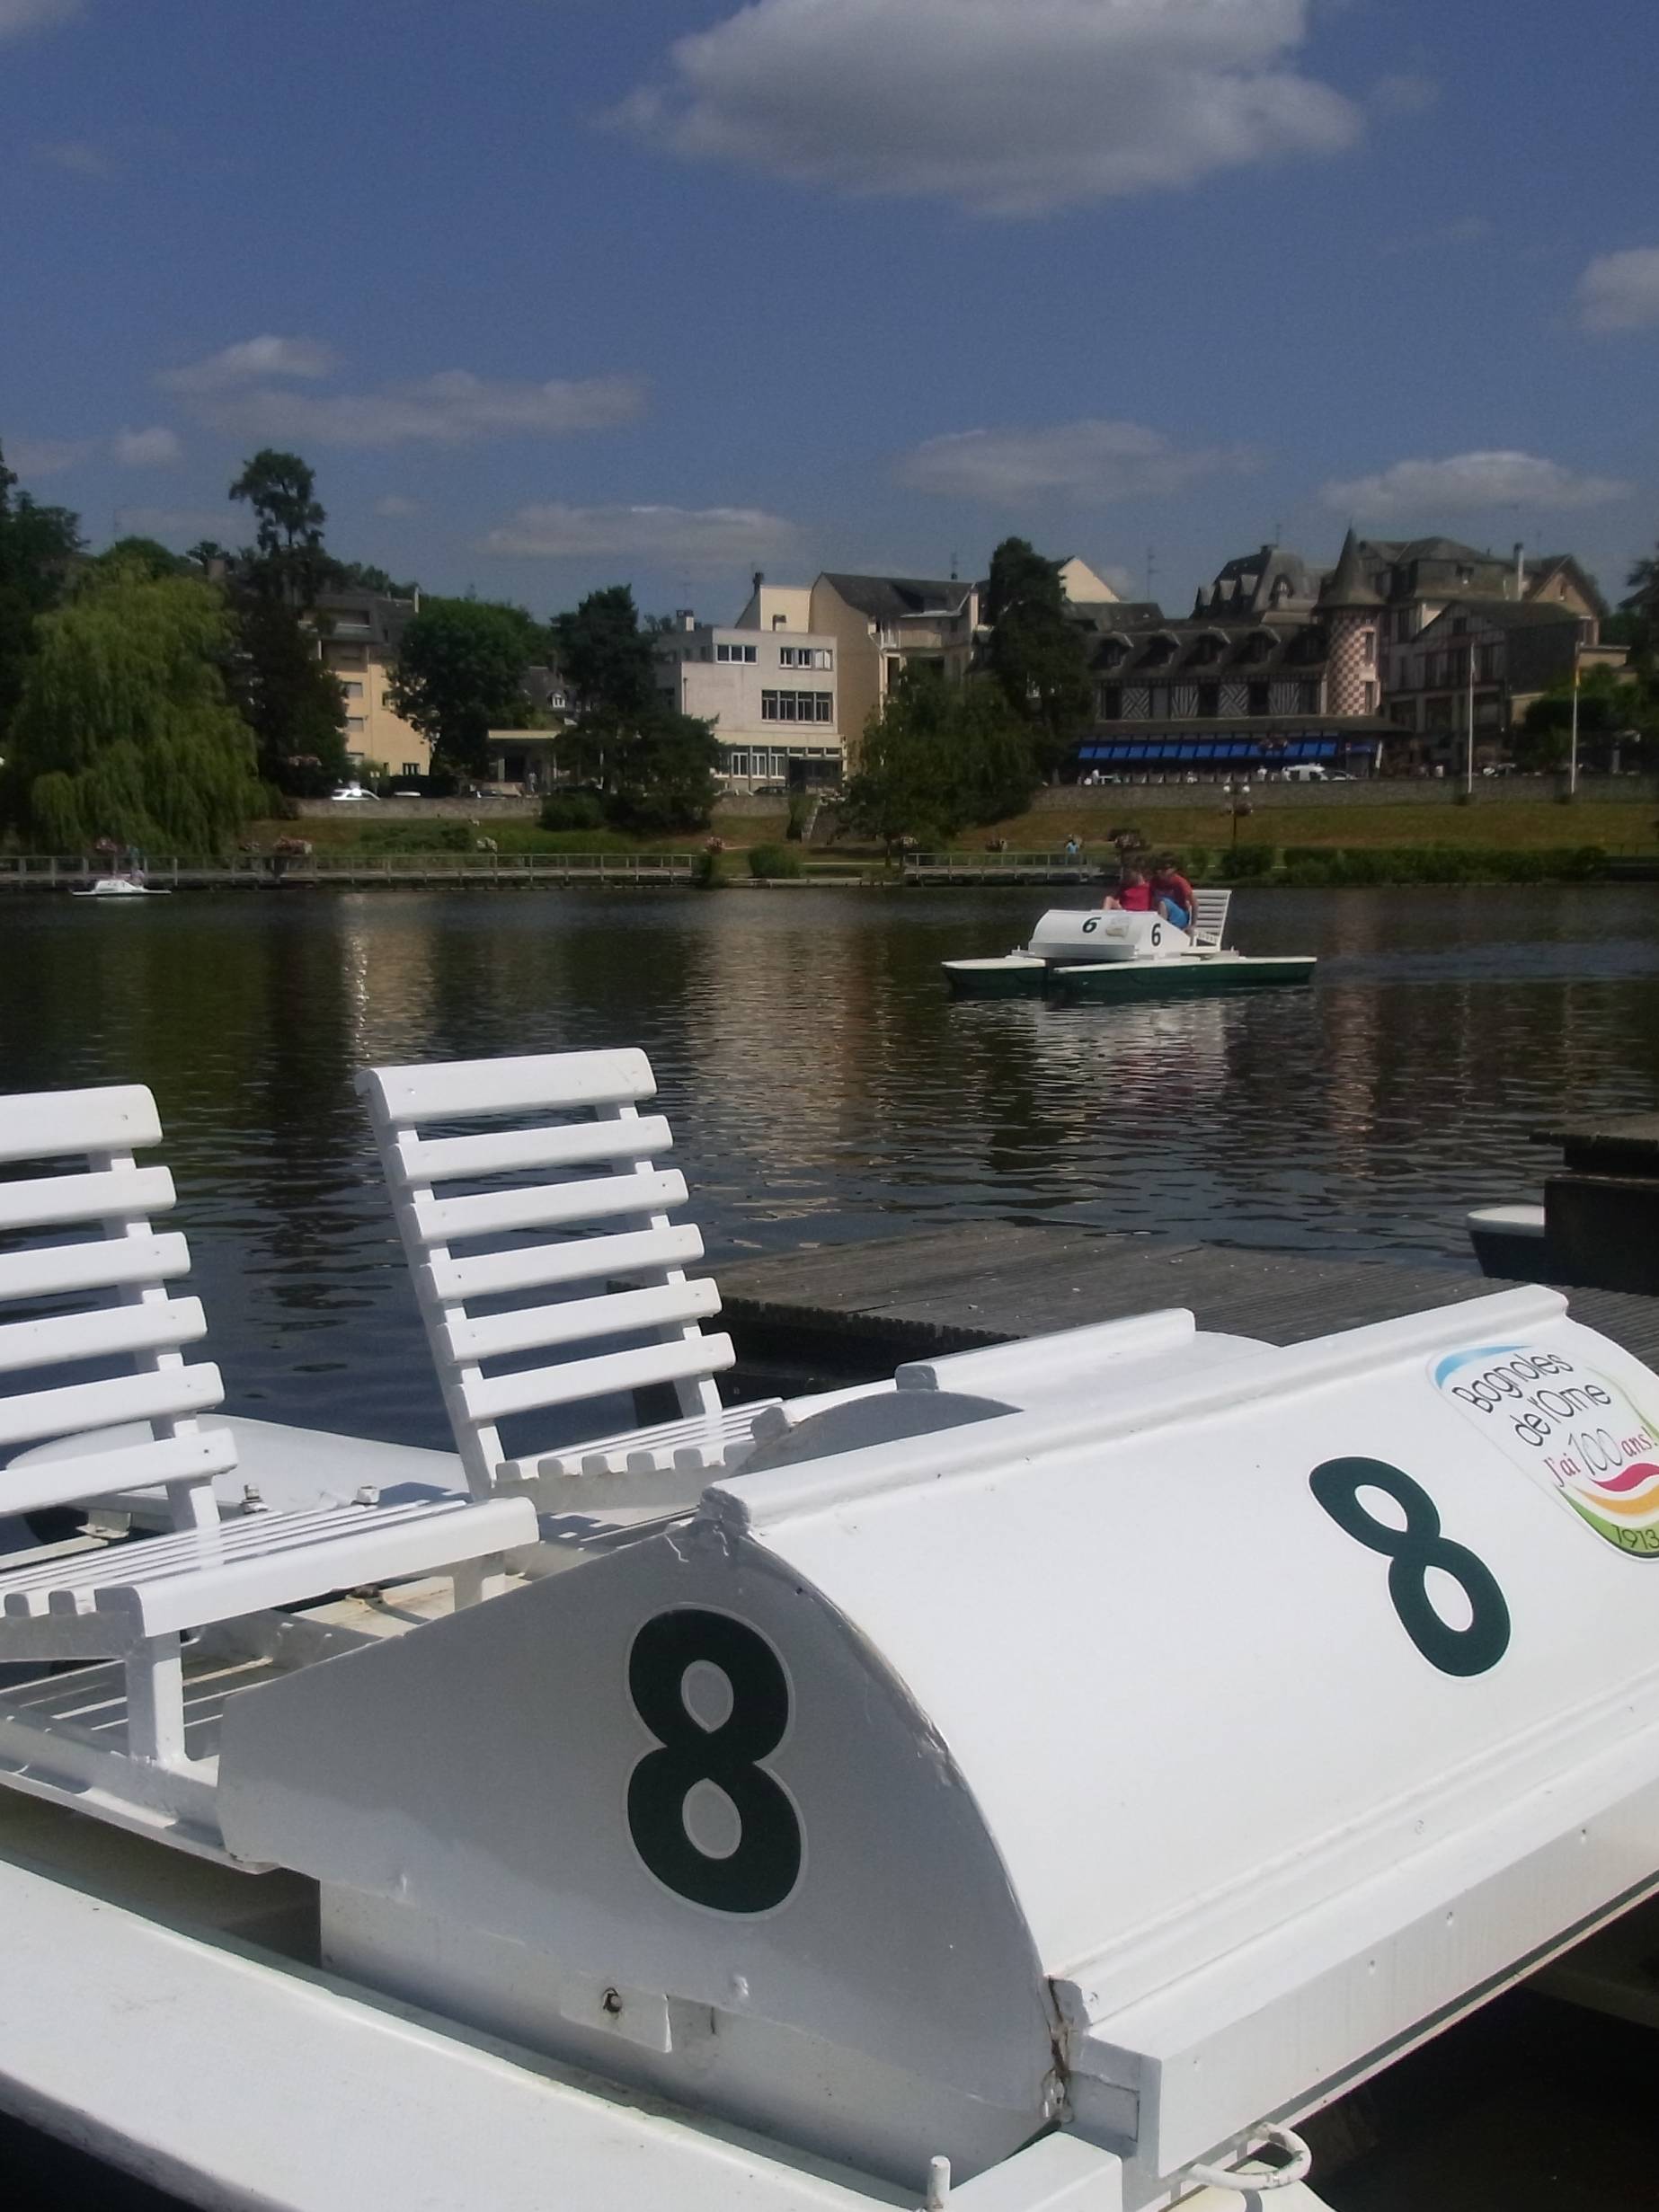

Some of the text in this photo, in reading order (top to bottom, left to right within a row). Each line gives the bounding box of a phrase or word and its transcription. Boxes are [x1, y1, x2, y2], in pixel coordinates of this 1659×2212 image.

[1082, 916, 1102, 933] 6
[1151, 923, 1162, 947] 6
[1451, 1353, 1574, 1413] Bagnoles
[1542, 1425, 1658, 1488] J'ai 100 ans!
[1309, 1456, 1512, 1677] 8
[1610, 1524, 1659, 1551] 1913
[627, 1609, 802, 1914] 8
